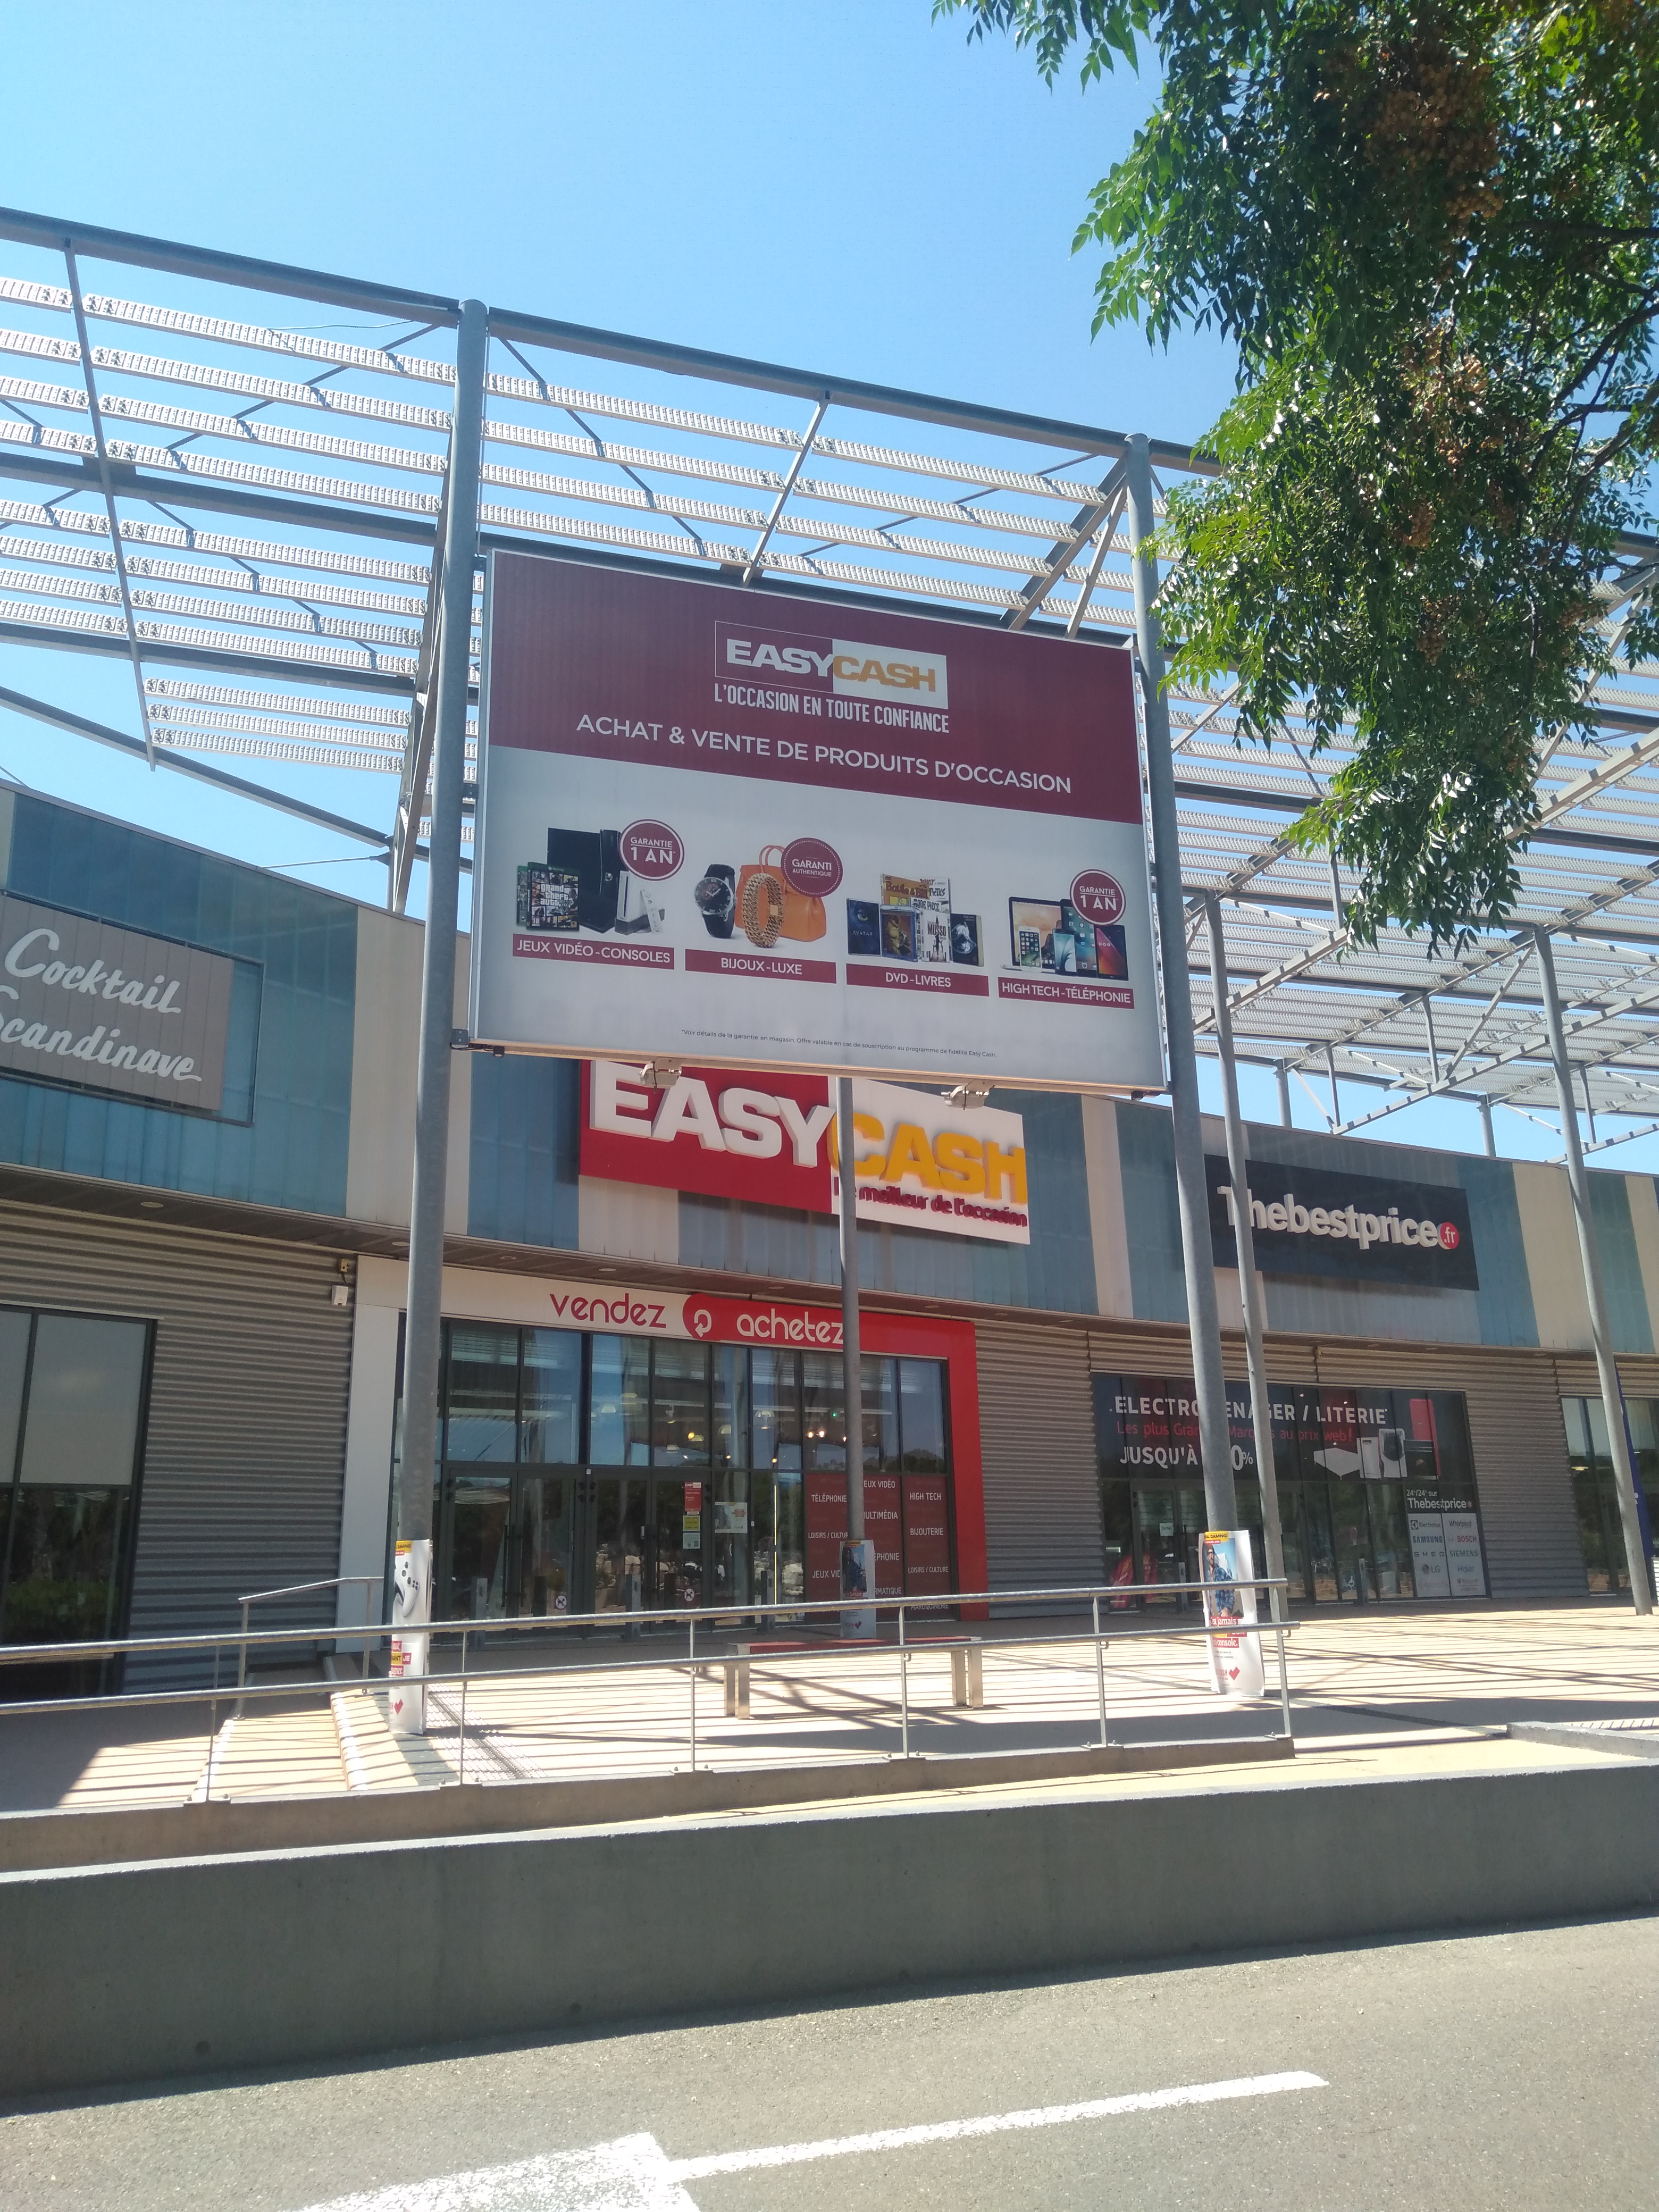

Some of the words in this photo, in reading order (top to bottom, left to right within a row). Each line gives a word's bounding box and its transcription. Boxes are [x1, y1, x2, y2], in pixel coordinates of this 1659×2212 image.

[715, 683, 799, 713] L'OCCASION
[804, 696, 822, 716] EN
[826, 699, 870, 723] TOUTE
[874, 706, 949, 733] CONFIANCE
[576, 714, 663, 741] ACHAT
[669, 726, 685, 744] &
[691, 729, 770, 756] VENTE
[777, 741, 808, 761] DE
[815, 745, 928, 776] PRODUITS
[935, 760, 1071, 793] D'OCCASION
[631, 837, 672, 848] GARANTIE
[631, 847, 637, 860] 1
[792, 859, 832, 870] GARANTI
[792, 868, 832, 877] AUTHENTIQUE
[1079, 886, 1115, 895] GARANTIE
[1080, 895, 1086, 908] 1
[927, 924, 946, 936] MUSSO
[517, 940, 550, 953] JEUX
[554, 942, 593, 956] VIDÉO
[4, 928, 181, 1013] Cocktail
[1002, 982, 1029, 994] HIGH
[1032, 985, 1059, 997] TECH
[859, 1185, 929, 1210] meilleur
[931, 1195, 952, 1214] de
[953, 1197, 1028, 1227] l'occasion
[549, 1293, 667, 1328] vendez
[736, 1309, 843, 1344] achetez
[1303, 1405, 1309, 1421] /
[1316, 1406, 1386, 1424] LITERIE
[1117, 1421, 1138, 1435] Les
[1144, 1422, 1169, 1438] plus
[1174, 1423, 1200, 1436] Gran
[1280, 1429, 1293, 1439] au
[1298, 1429, 1319, 1442] prix
[877, 1479, 895, 1488] VIDÉO
[811, 1493, 847, 1502] TÉLÉPHONIE
[864, 1510, 898, 1519] ULTIMÉDIA
[1217, 1617, 1237, 1627] jamais
